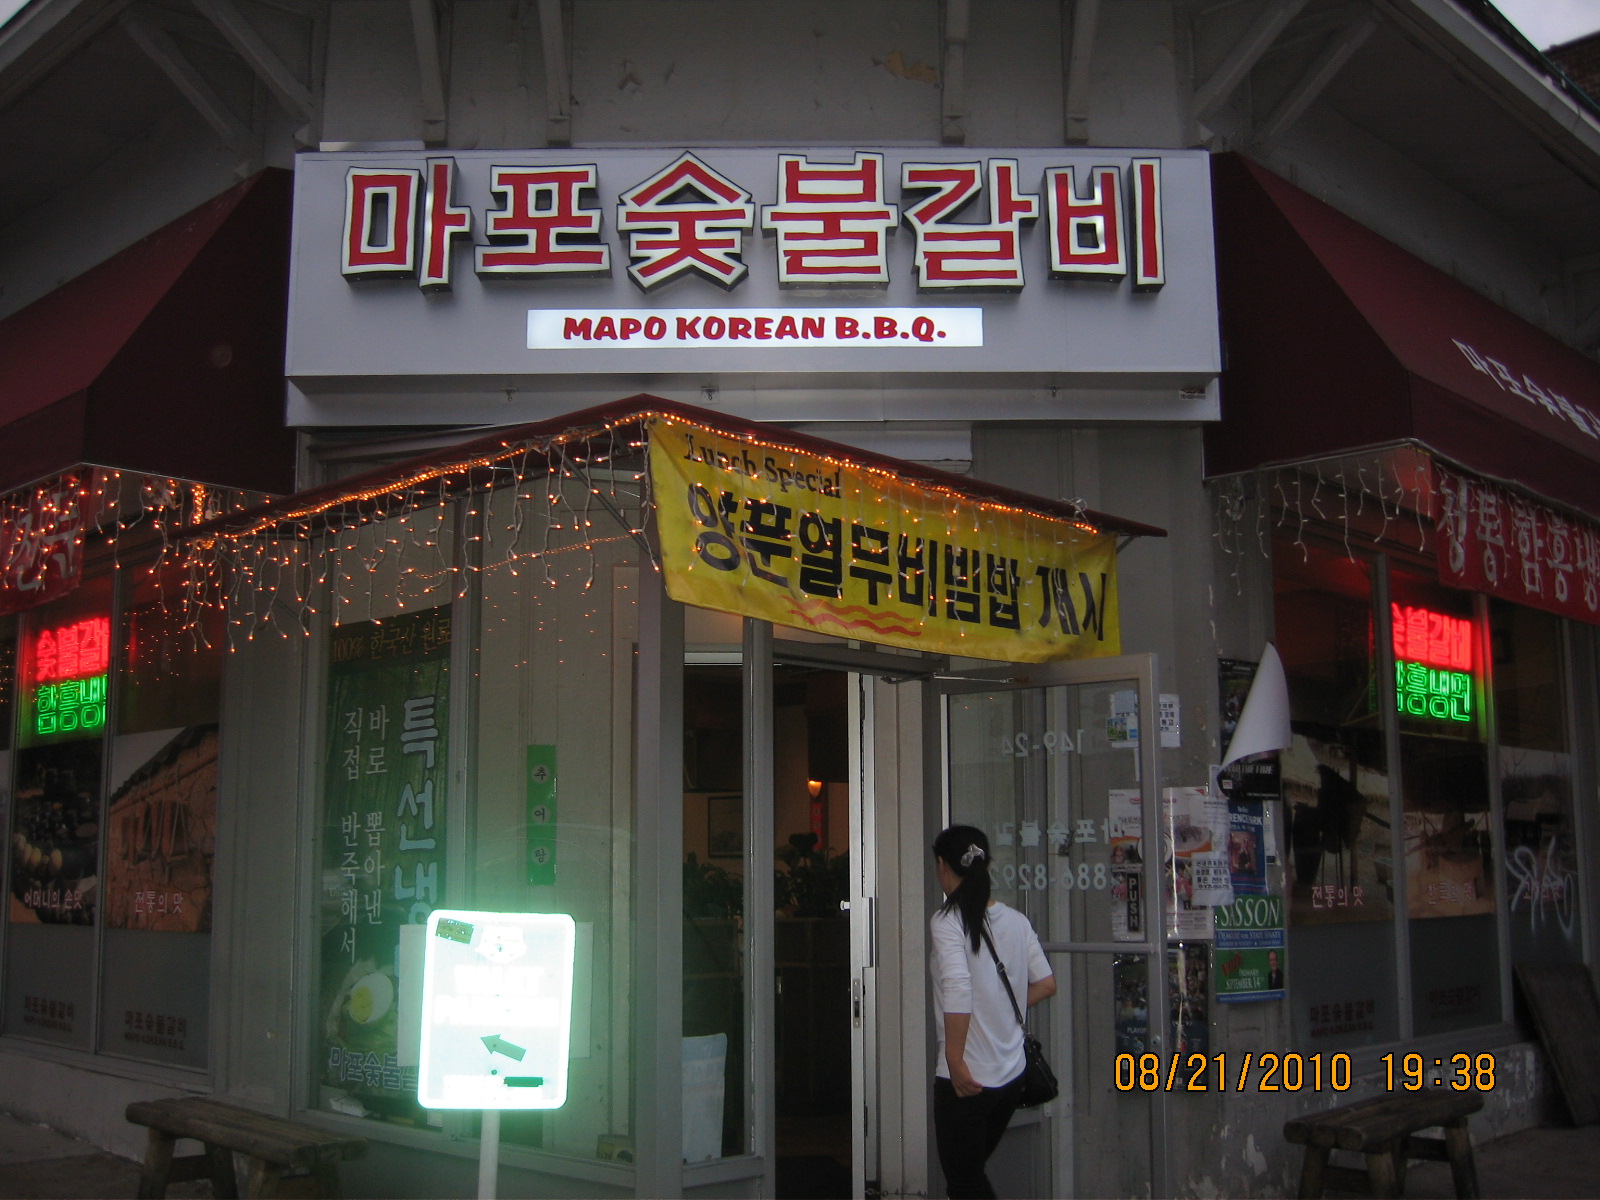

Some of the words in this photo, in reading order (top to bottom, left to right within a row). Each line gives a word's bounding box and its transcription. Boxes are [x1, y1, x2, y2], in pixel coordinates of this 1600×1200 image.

[341, 150, 1165, 290] 마포숯불갈비
[564, 318, 666, 342] MAPO
[676, 317, 824, 342] KOREAN
[836, 317, 949, 345] B.B.Q.
[683, 433, 767, 479] Lunch
[763, 457, 843, 498] Special
[36, 617, 110, 683] 숯불갈
[37, 675, 107, 734] 함흥냉
[343, 708, 363, 781] 직접
[365, 705, 389, 776] 바로
[364, 812, 386, 925] 뽑아낸
[1312, 886, 1348, 908] 전통의
[1353, 886, 1364, 907] 맛
[135, 891, 168, 914] 전통의
[173, 893, 184, 914] 맛
[1128, 877, 1139, 931] PUSH
